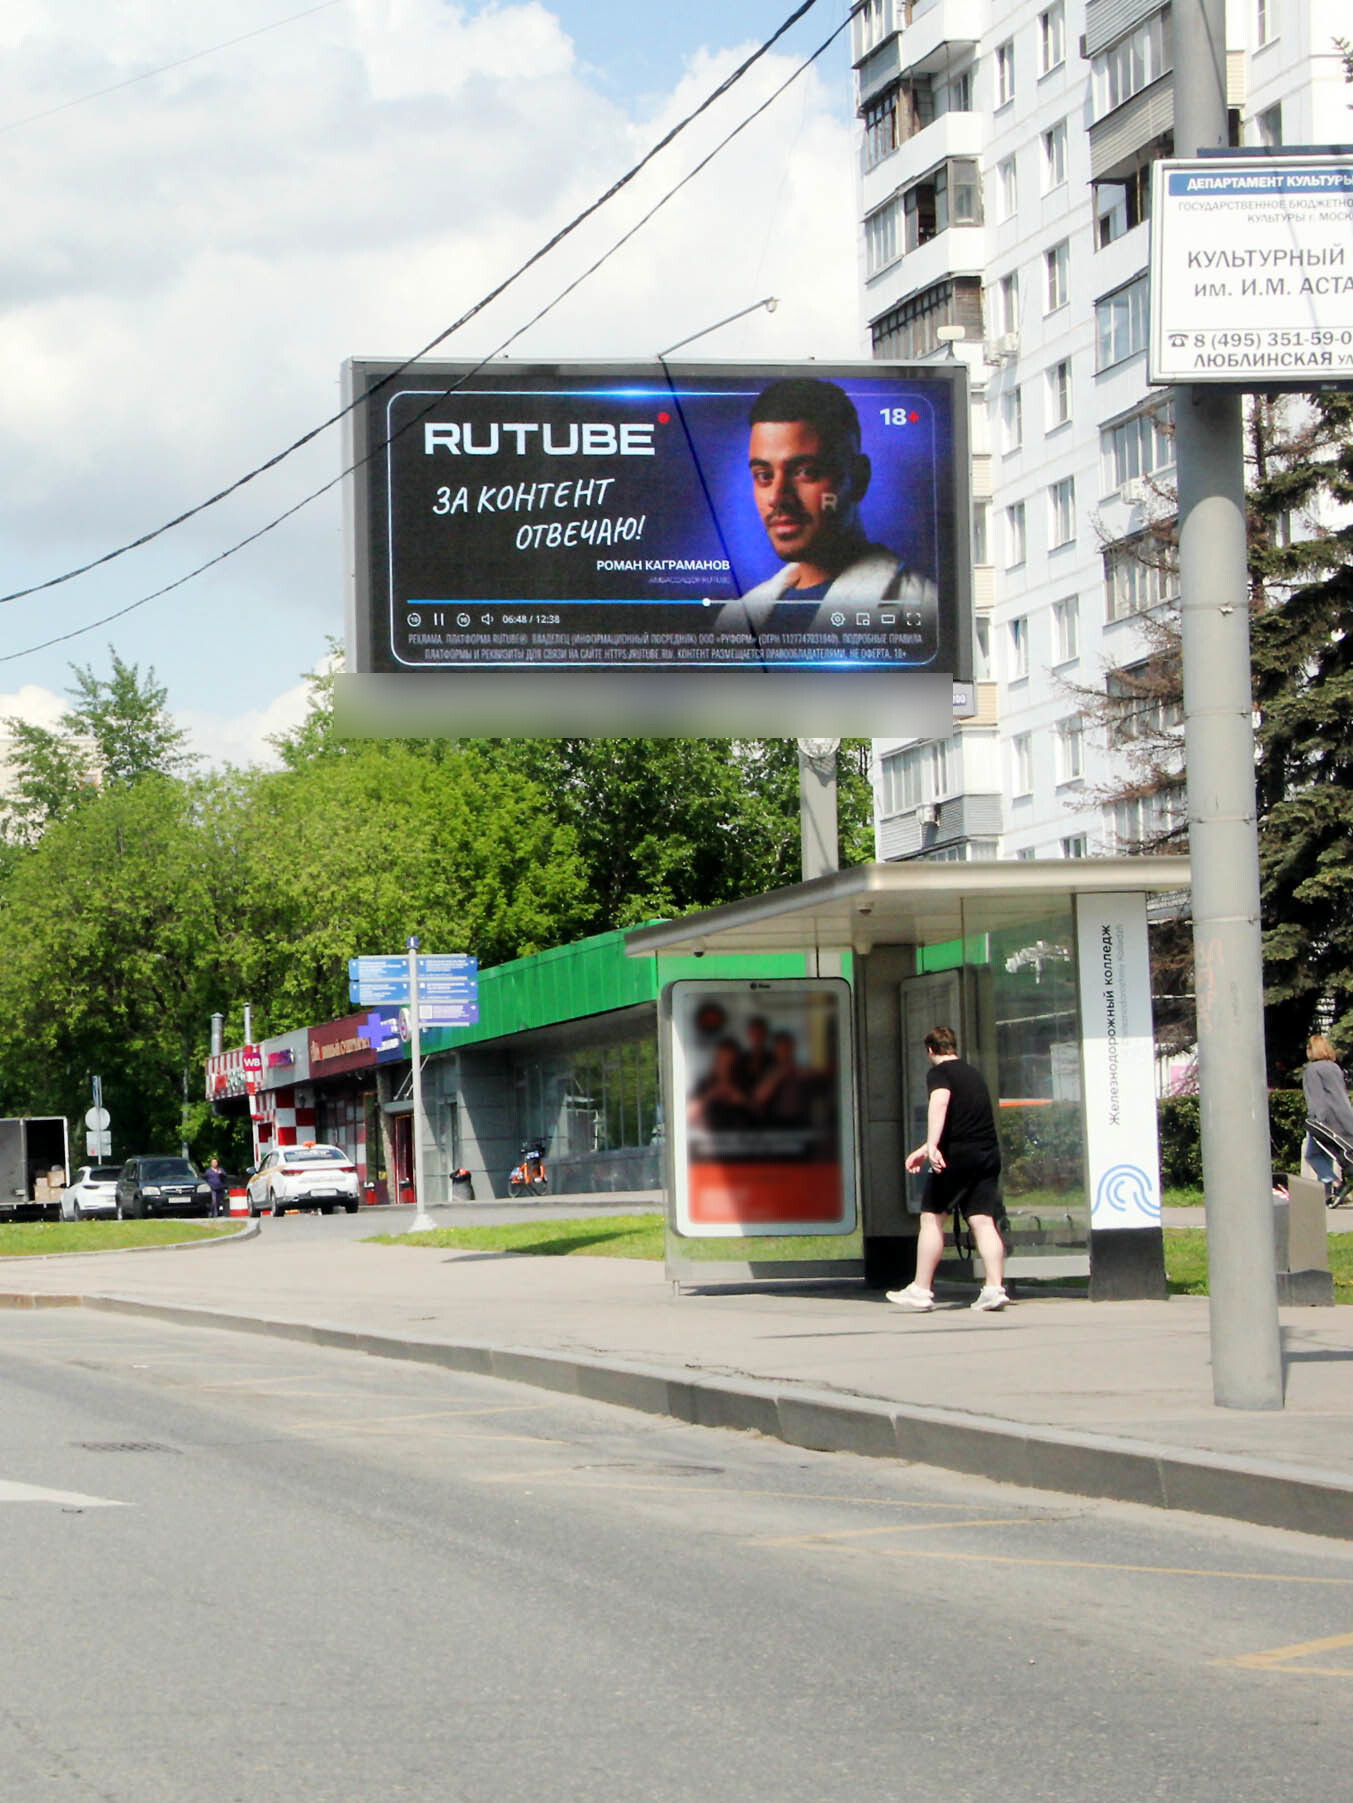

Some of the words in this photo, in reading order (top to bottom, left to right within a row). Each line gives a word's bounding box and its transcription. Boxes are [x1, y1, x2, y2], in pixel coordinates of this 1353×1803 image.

[1186, 176, 1284, 191] ДЕПАРТАМЕНТ
[1178, 200, 1285, 212] ГОСУДАРСТВЕННОЕ
[1248, 212, 1304, 223] КУЛЬТУРЫ
[1187, 243, 1344, 268] КУЛЬТУРНЫЙ
[1194, 283, 1232, 297] им.
[1241, 278, 1291, 296] И.М.
[1194, 333, 1205, 348] 8
[1211, 332, 1261, 350] (495)
[1194, 352, 1332, 368] ЛЮБЛИНСКАЯ
[880, 408, 919, 425] 18+
[424, 423, 655, 455] RUTUBE
[432, 486, 468, 515] ЗА
[477, 478, 615, 513] КОНТЕНТ
[515, 515, 646, 550] ОТВЕЧАЮ!
[597, 560, 642, 571] РОМАН
[645, 559, 730, 571] КАГРАМАНОВ
[502, 615, 528, 624] 06:48
[536, 615, 560, 624] 12:38
[1101, 924, 1115, 986] колледж
[244, 1057, 261, 1066] WB
[1102, 991, 1121, 1126] Железнодорожный
